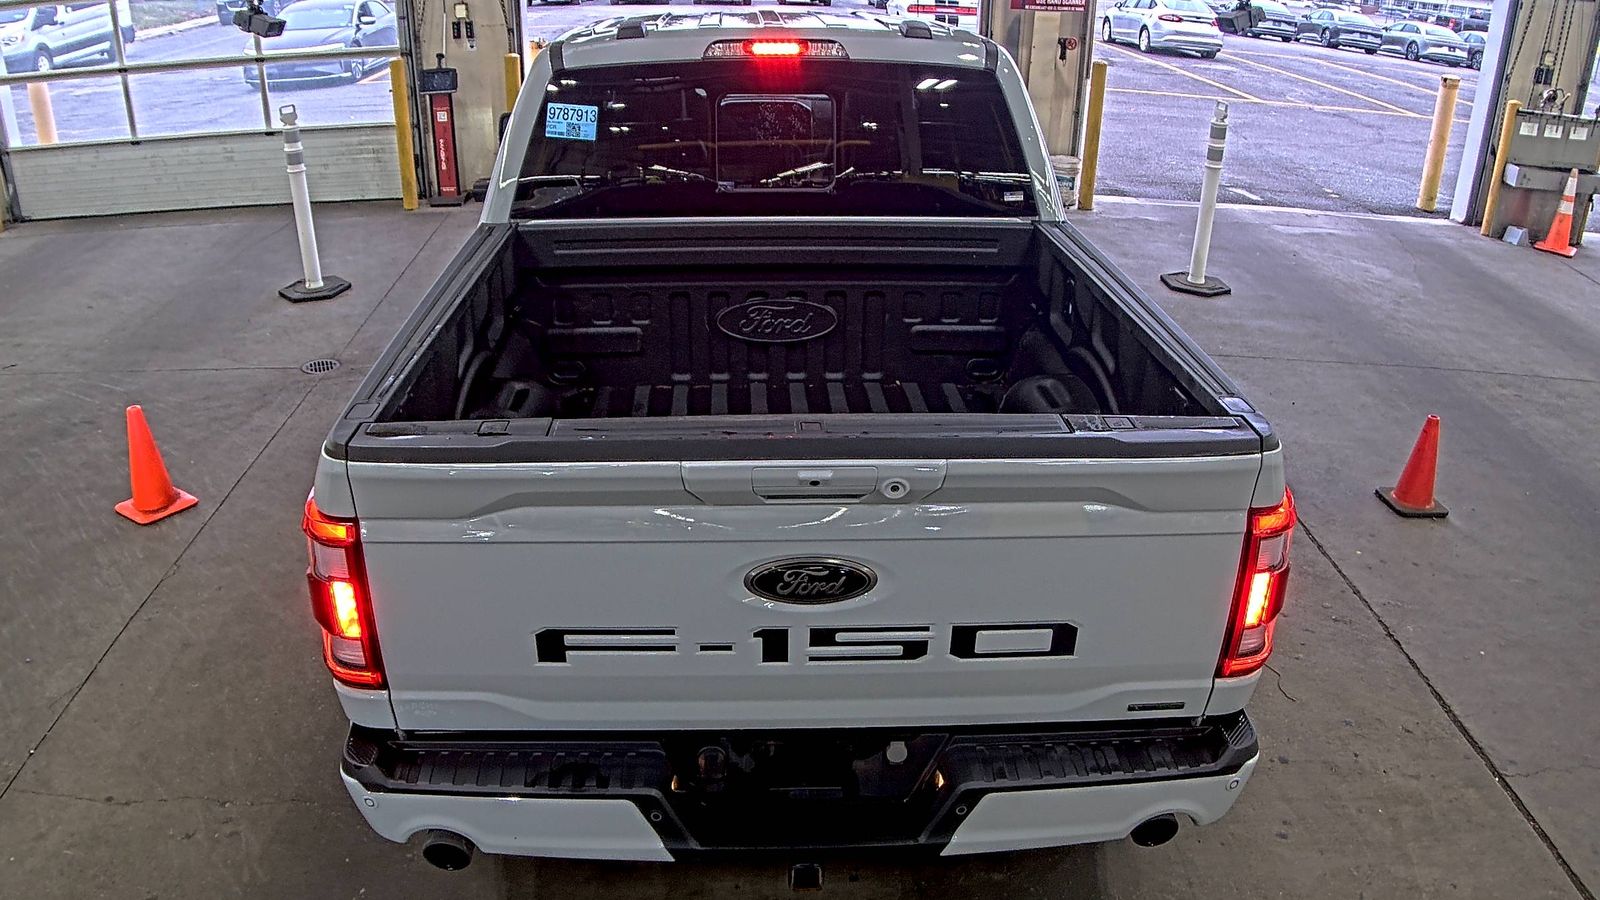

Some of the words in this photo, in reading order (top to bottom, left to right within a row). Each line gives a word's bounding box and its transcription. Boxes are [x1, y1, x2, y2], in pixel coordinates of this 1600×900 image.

[548, 106, 597, 123] 9787913
[739, 304, 813, 333] Ford
[776, 568, 847, 595] Ford
[534, 622, 1079, 665] F-150
